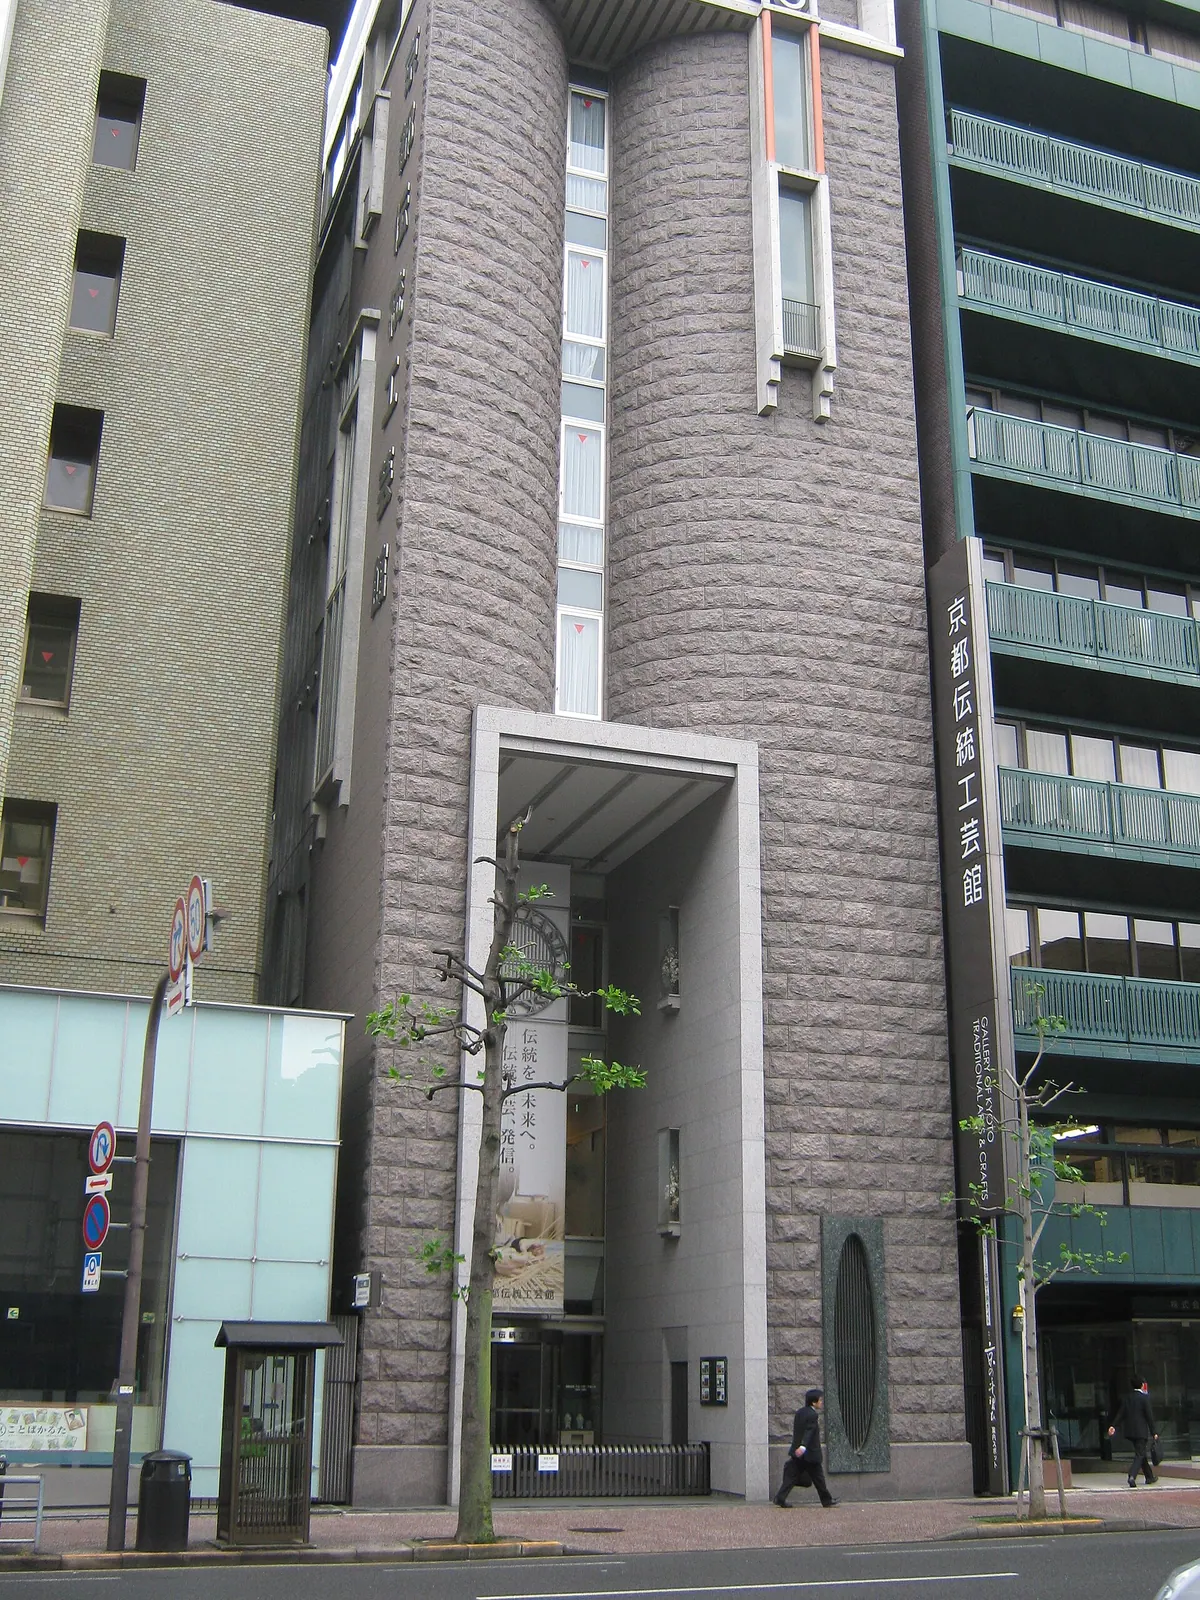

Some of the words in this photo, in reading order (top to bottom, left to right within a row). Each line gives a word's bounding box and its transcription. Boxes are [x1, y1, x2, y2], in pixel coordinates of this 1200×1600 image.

[947, 595, 984, 907] 京都伝統工芸館
[972, 1019, 984, 1102] TRADITIONAL
[981, 1016, 991, 1073] GALLERY
[500, 1045, 518, 1173] 伝統芸、発信。
[984, 1075, 992, 1095] OF
[977, 1104, 986, 1135] ARS
[978, 1138, 986, 1148] &
[985, 1097, 995, 1143] KYOTO
[979, 1151, 989, 1202] CRAFTS
